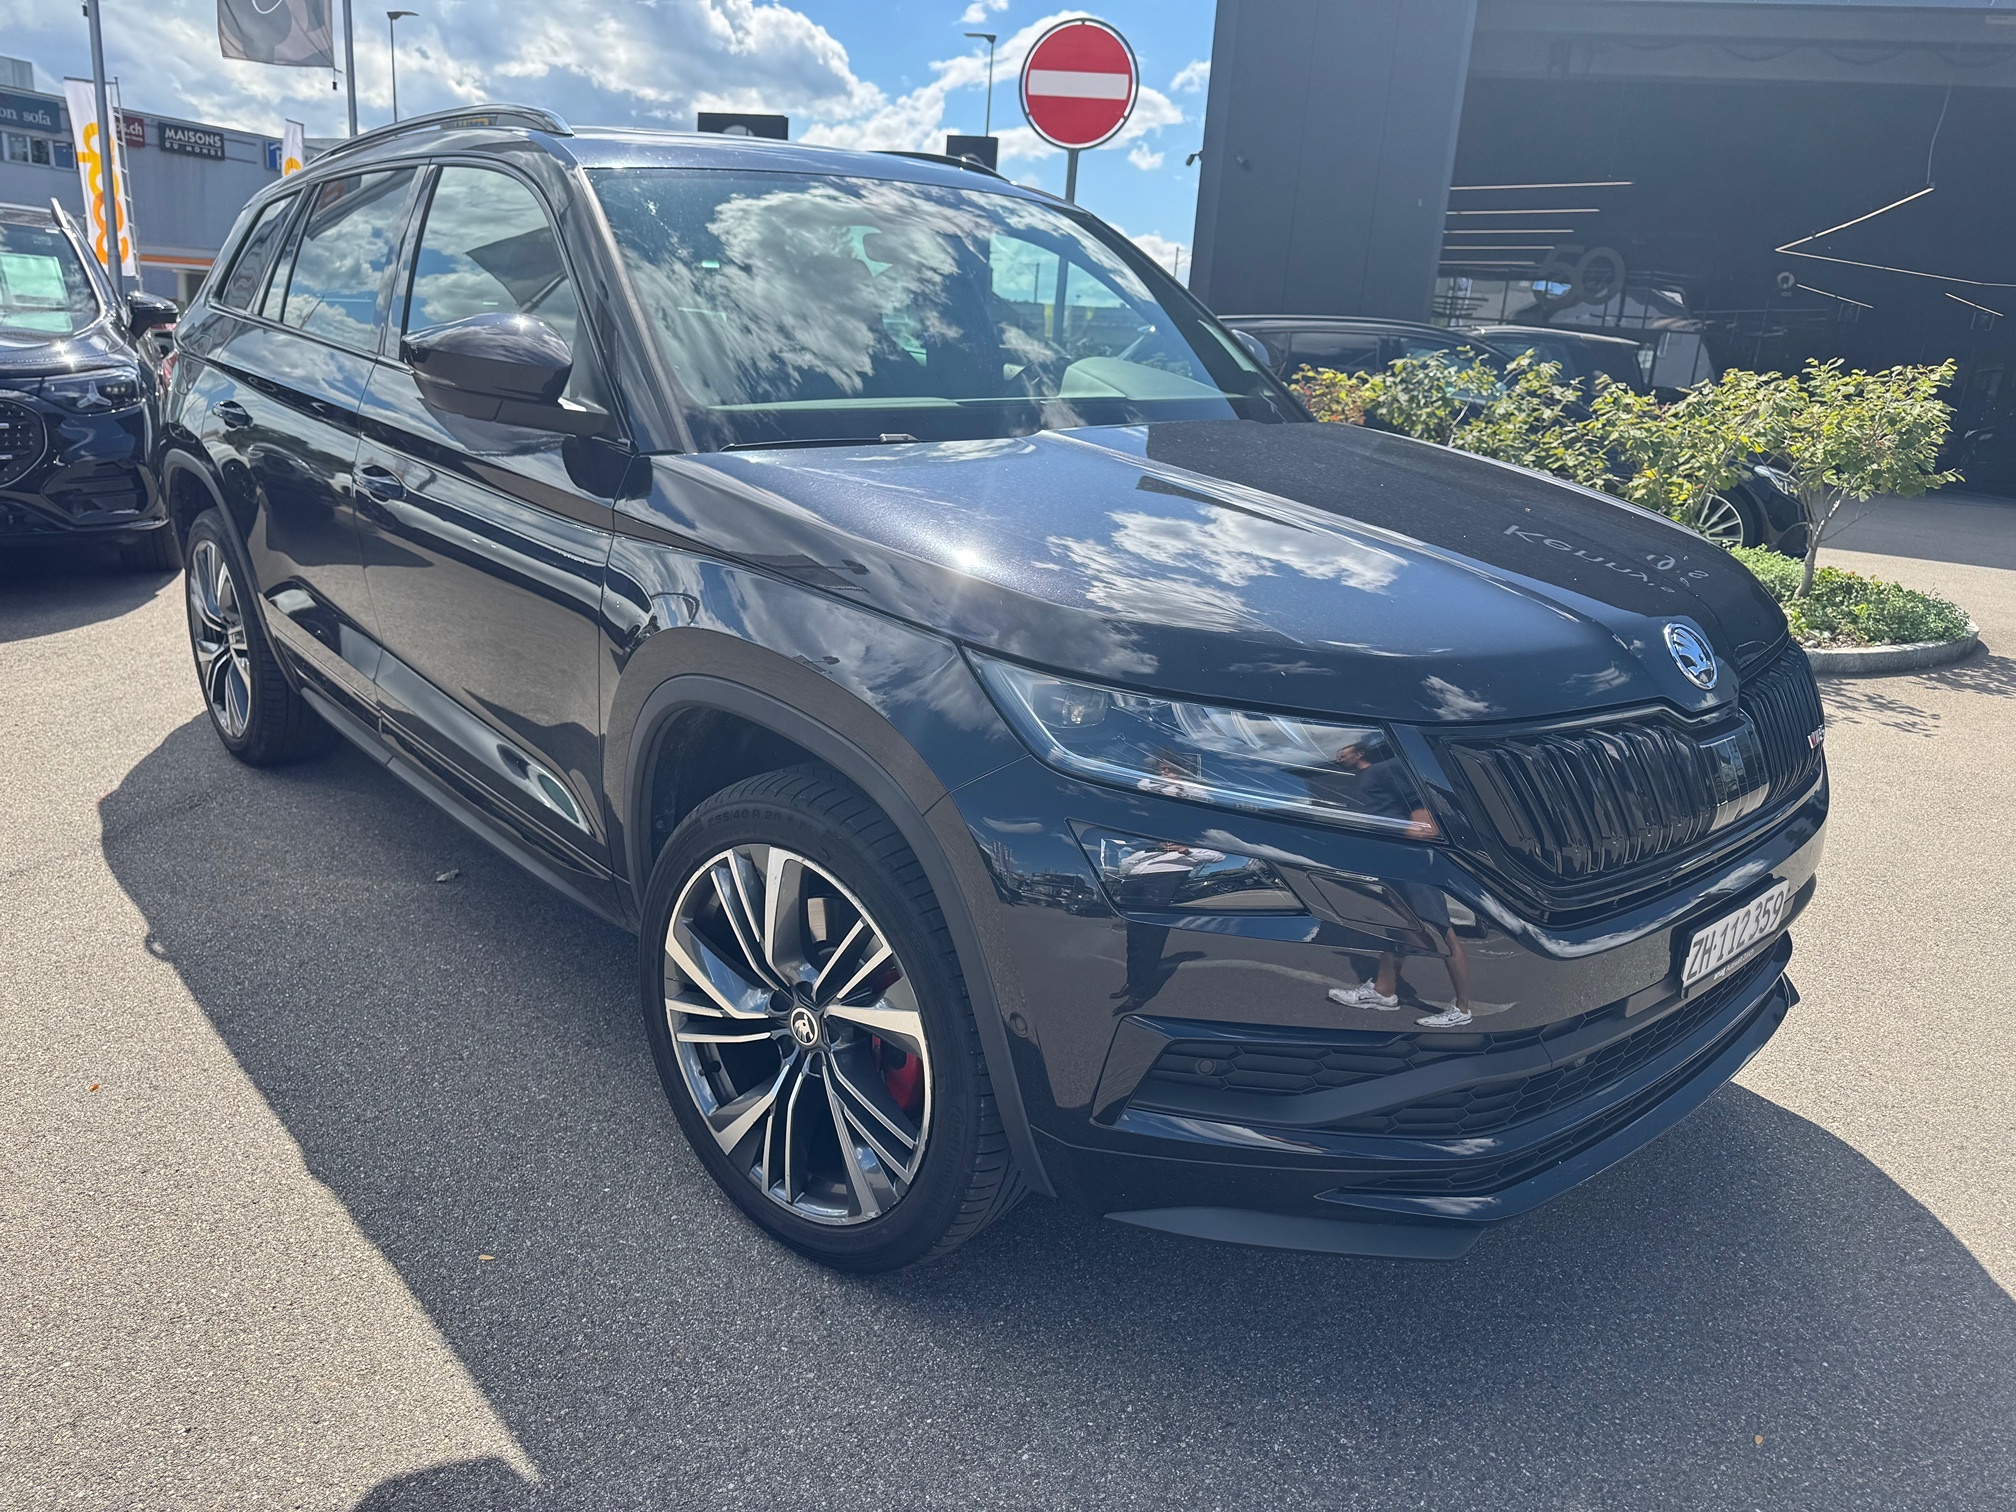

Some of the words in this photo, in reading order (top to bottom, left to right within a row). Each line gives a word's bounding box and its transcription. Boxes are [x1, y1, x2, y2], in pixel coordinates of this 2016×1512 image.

[22, 109, 51, 126] sofa
[165, 127, 222, 147] MAISONS
[165, 141, 179, 150] DU
